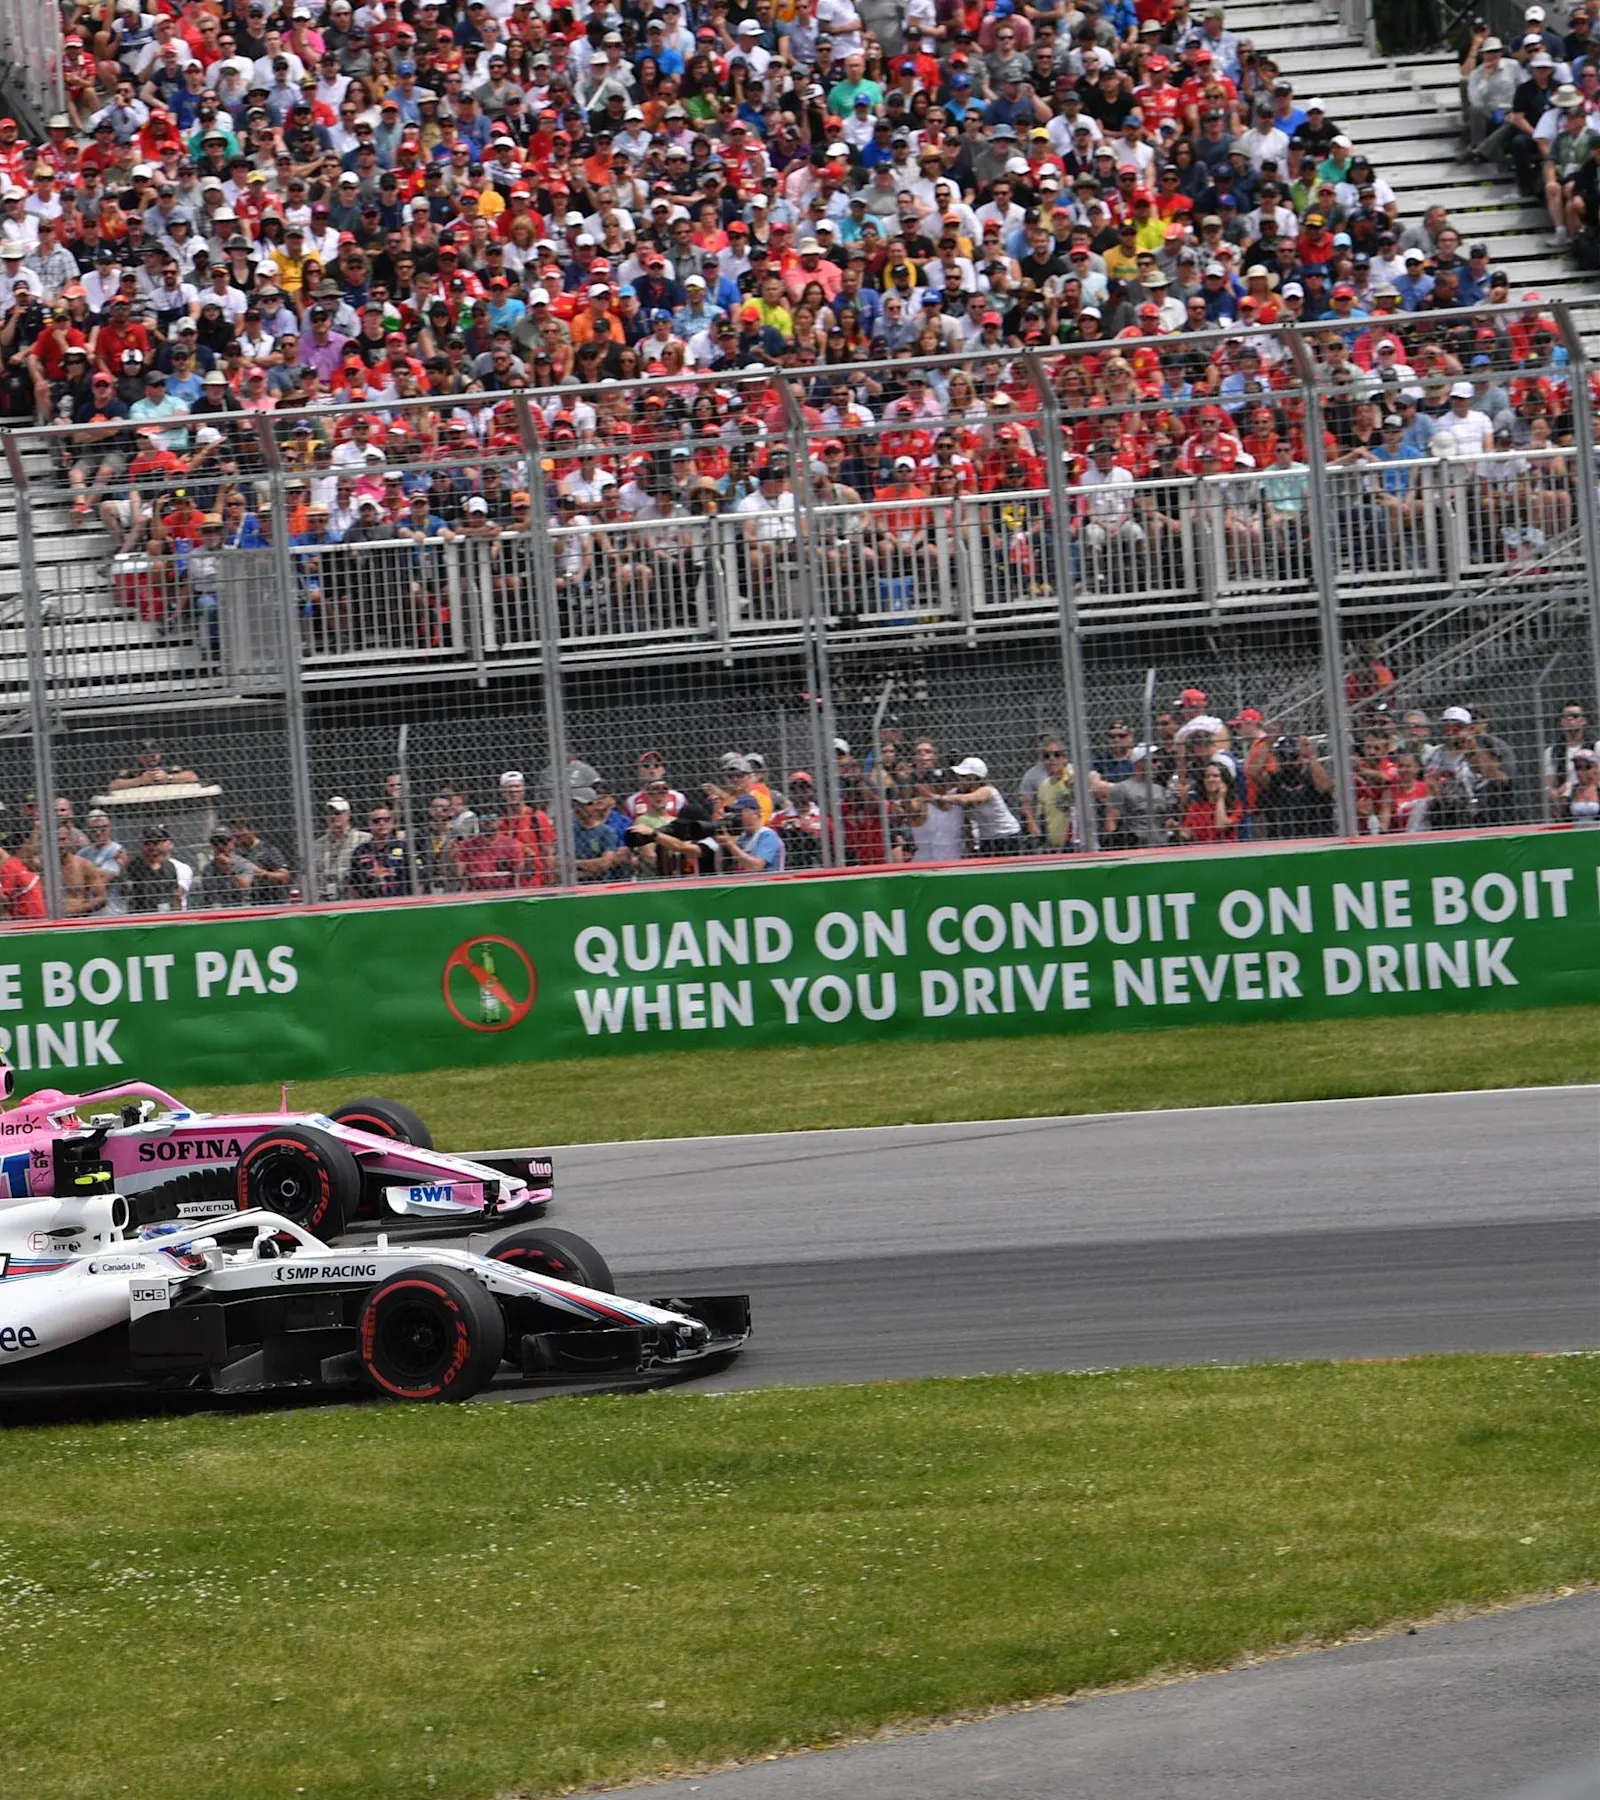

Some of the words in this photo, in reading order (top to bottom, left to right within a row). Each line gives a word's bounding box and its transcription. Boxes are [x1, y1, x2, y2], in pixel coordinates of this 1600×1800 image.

[575, 916, 793, 977] QUAND
[816, 909, 907, 961] ON
[927, 892, 1195, 955] CONDUIT
[1219, 886, 1313, 939] ON
[1334, 879, 1412, 931] NE
[1432, 868, 1573, 926] BOIT
[42, 954, 175, 1008] BOIT
[196, 945, 298, 998] PAS
[574, 977, 754, 1035] WHEN
[771, 972, 896, 1024] YOU
[921, 961, 1090, 1017] DRIVE
[1113, 951, 1302, 1007] NEVER
[1323, 937, 1519, 996] DRINK
[138, 1138, 243, 1162] SOFINA
[528, 1160, 552, 1175] duo
[183, 1202, 237, 1214] RAVENOL
[32, 1233, 43, 1251] E
[102, 1262, 131, 1272] Canada
[131, 1262, 146, 1271] Life
[286, 1267, 319, 1280] SMP
[321, 1264, 377, 1278] RACING
[133, 1289, 166, 1301] JCB
